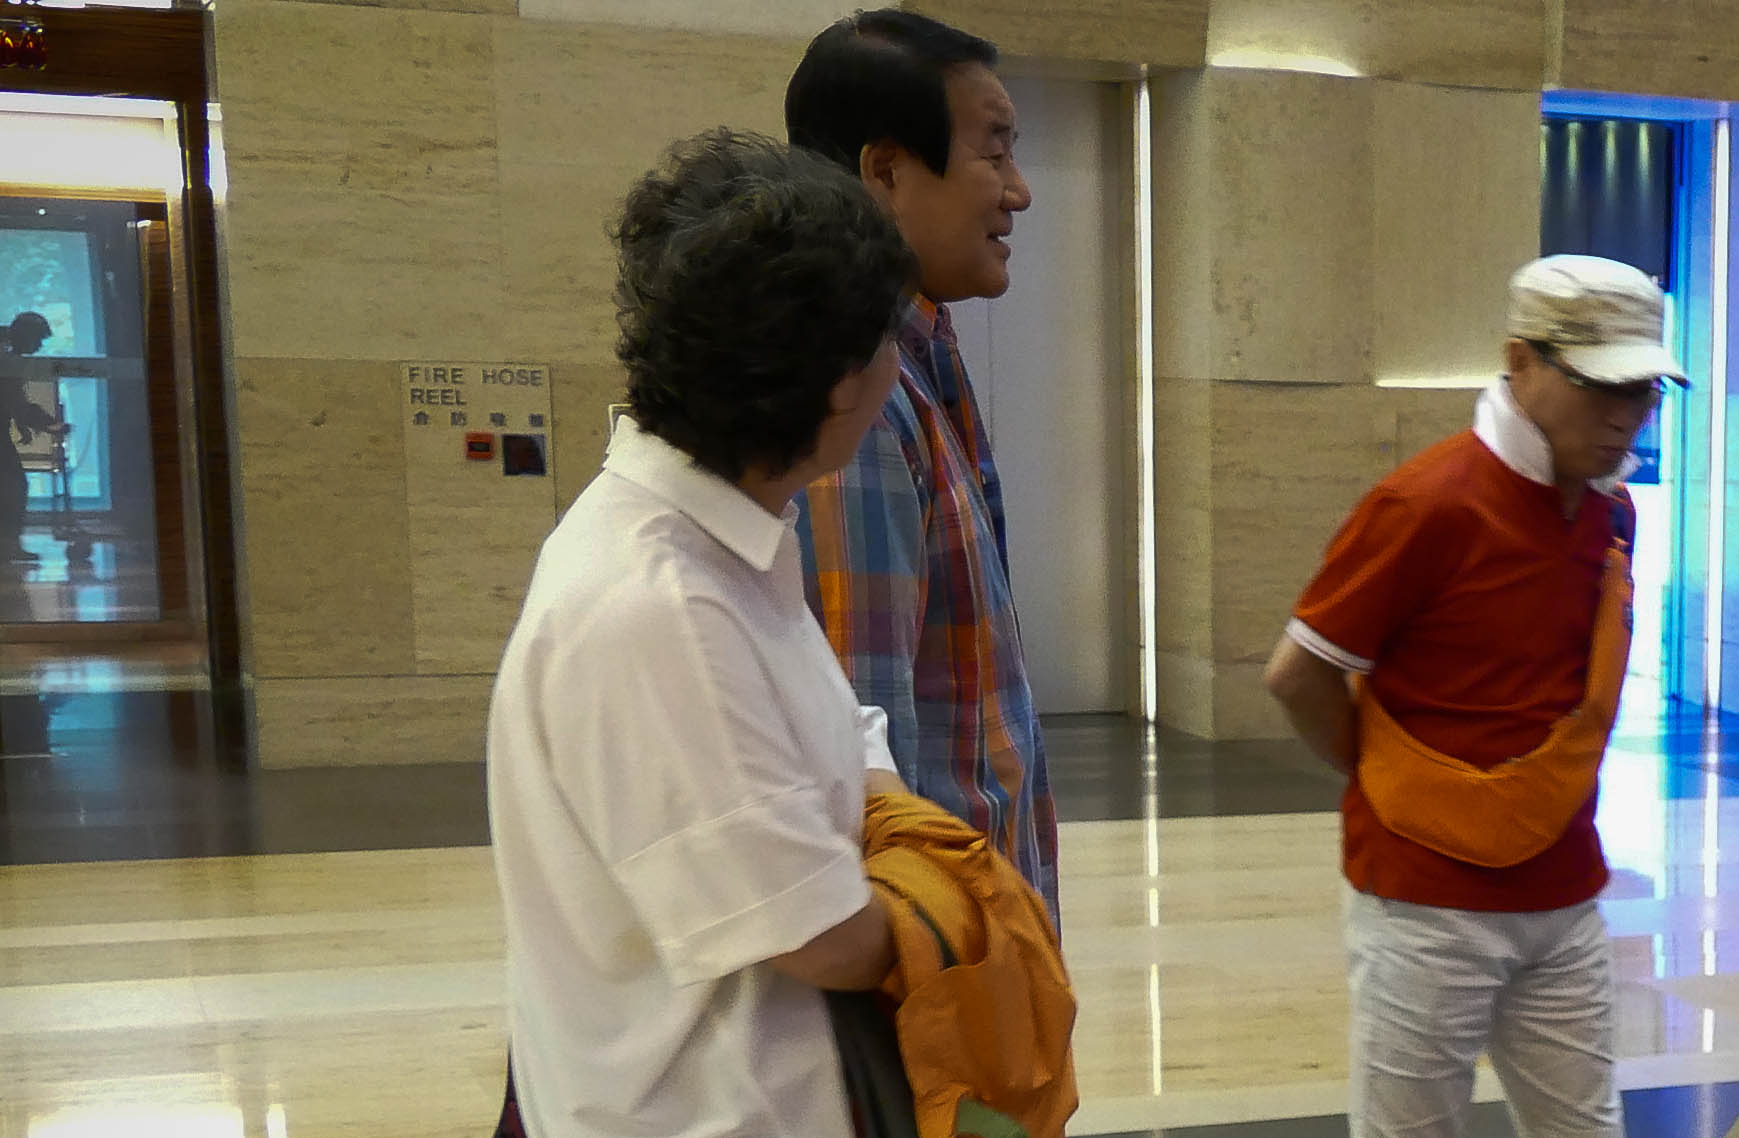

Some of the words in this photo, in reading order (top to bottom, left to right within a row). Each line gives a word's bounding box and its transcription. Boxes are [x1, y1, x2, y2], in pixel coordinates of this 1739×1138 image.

[408, 366, 464, 385] FIRE
[481, 368, 543, 387] HOSE
[410, 388, 467, 405] REEL
